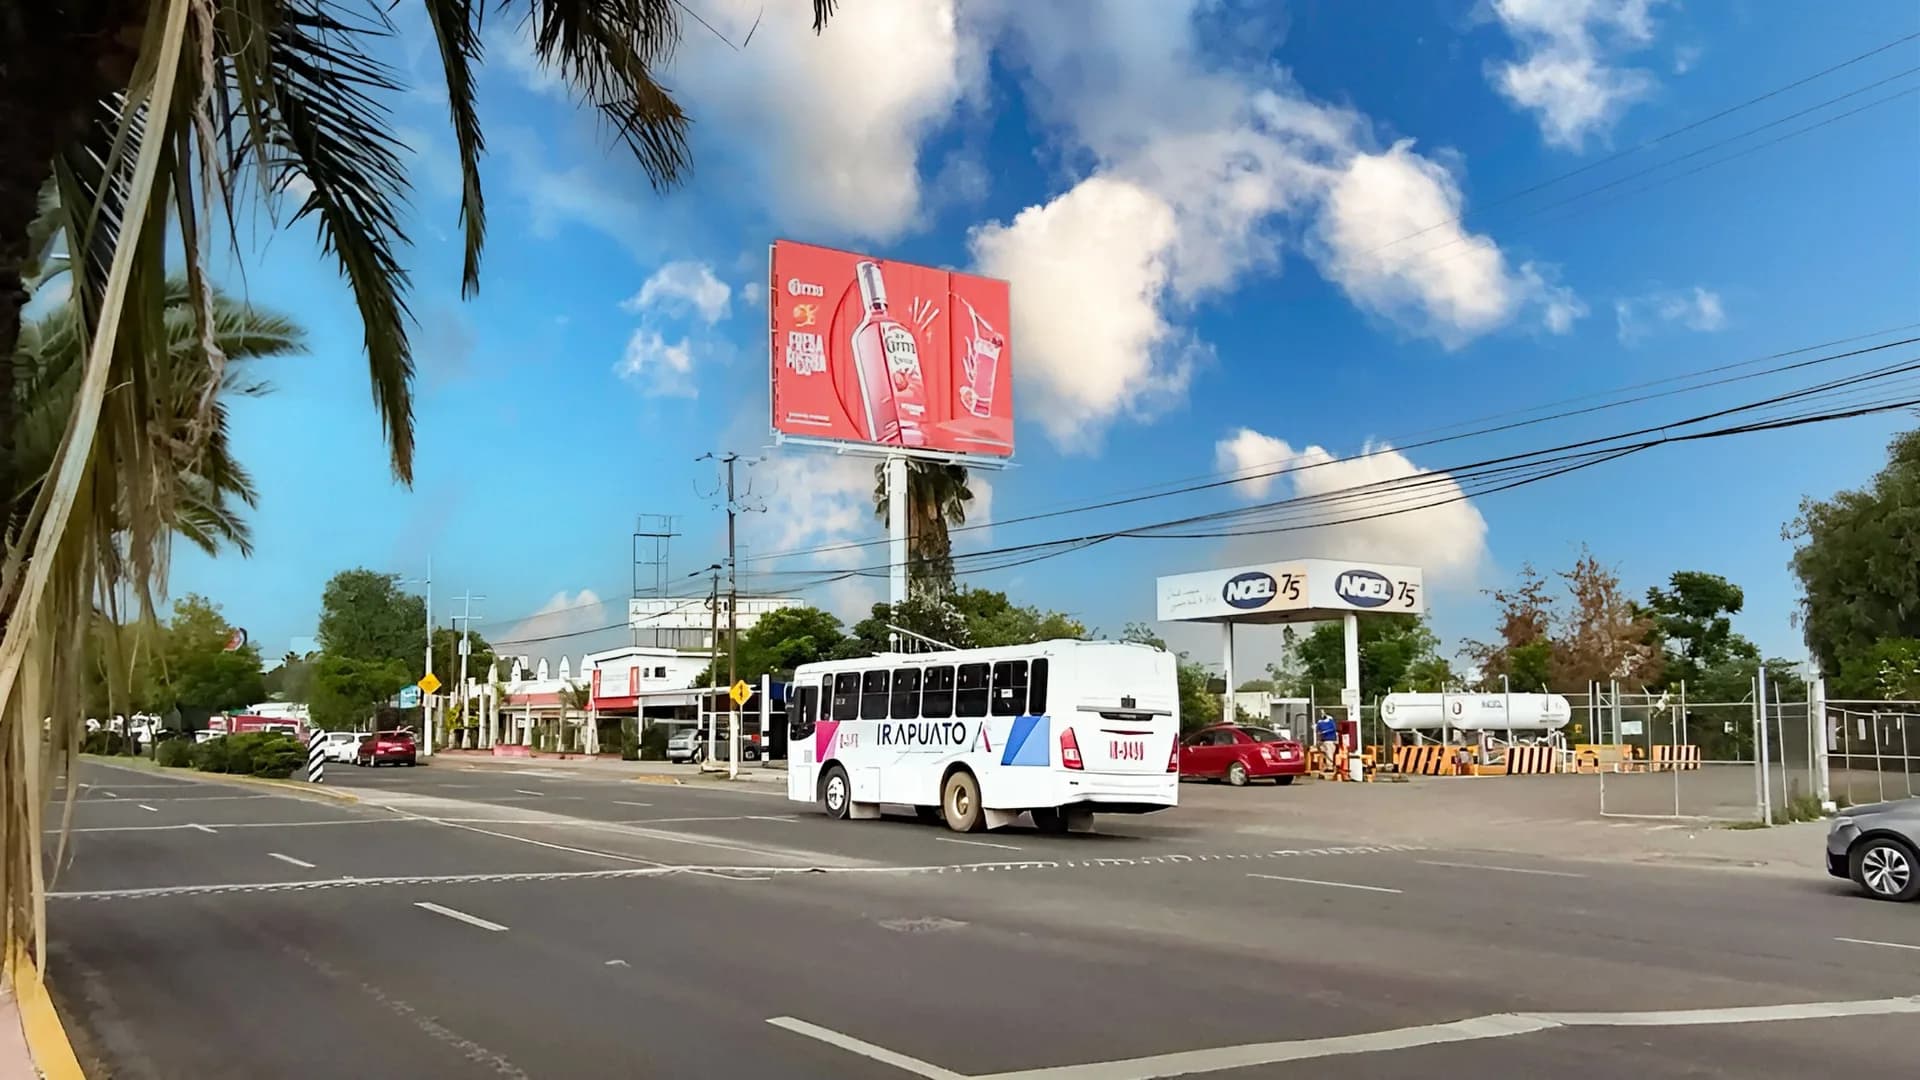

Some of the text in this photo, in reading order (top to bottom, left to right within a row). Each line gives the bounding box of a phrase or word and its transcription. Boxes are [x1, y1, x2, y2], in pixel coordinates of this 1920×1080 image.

[1226, 577, 1276, 602] NOEL
[1281, 573, 1300, 601] 75
[1339, 575, 1416, 608] NOEL 75
[876, 721, 966, 746] IRAPUATO
